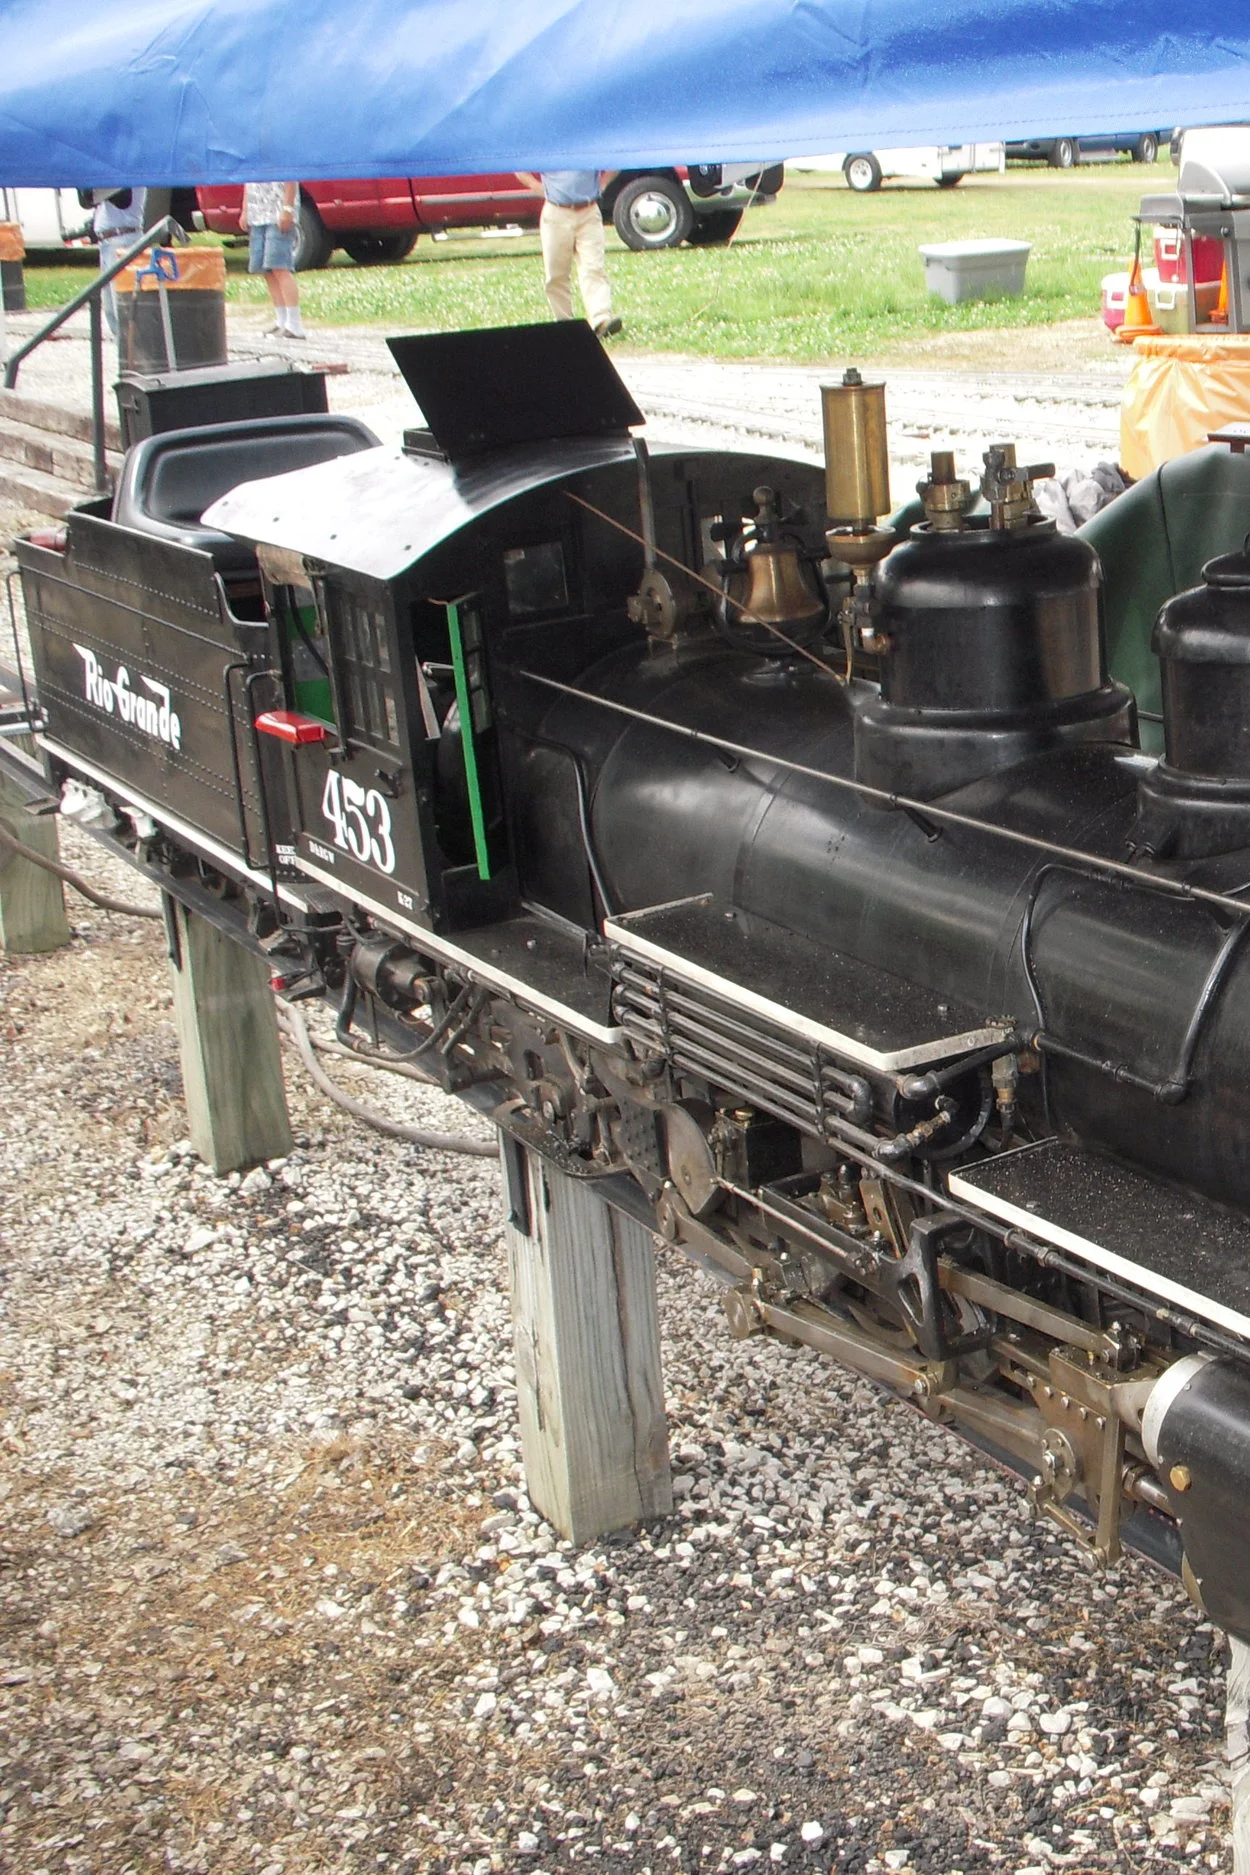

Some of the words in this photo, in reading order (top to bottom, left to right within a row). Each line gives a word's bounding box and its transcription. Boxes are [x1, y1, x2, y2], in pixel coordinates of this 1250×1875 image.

[72, 642, 114, 713] Rio
[109, 665, 181, 750] Grande
[322, 768, 396, 875] 453
